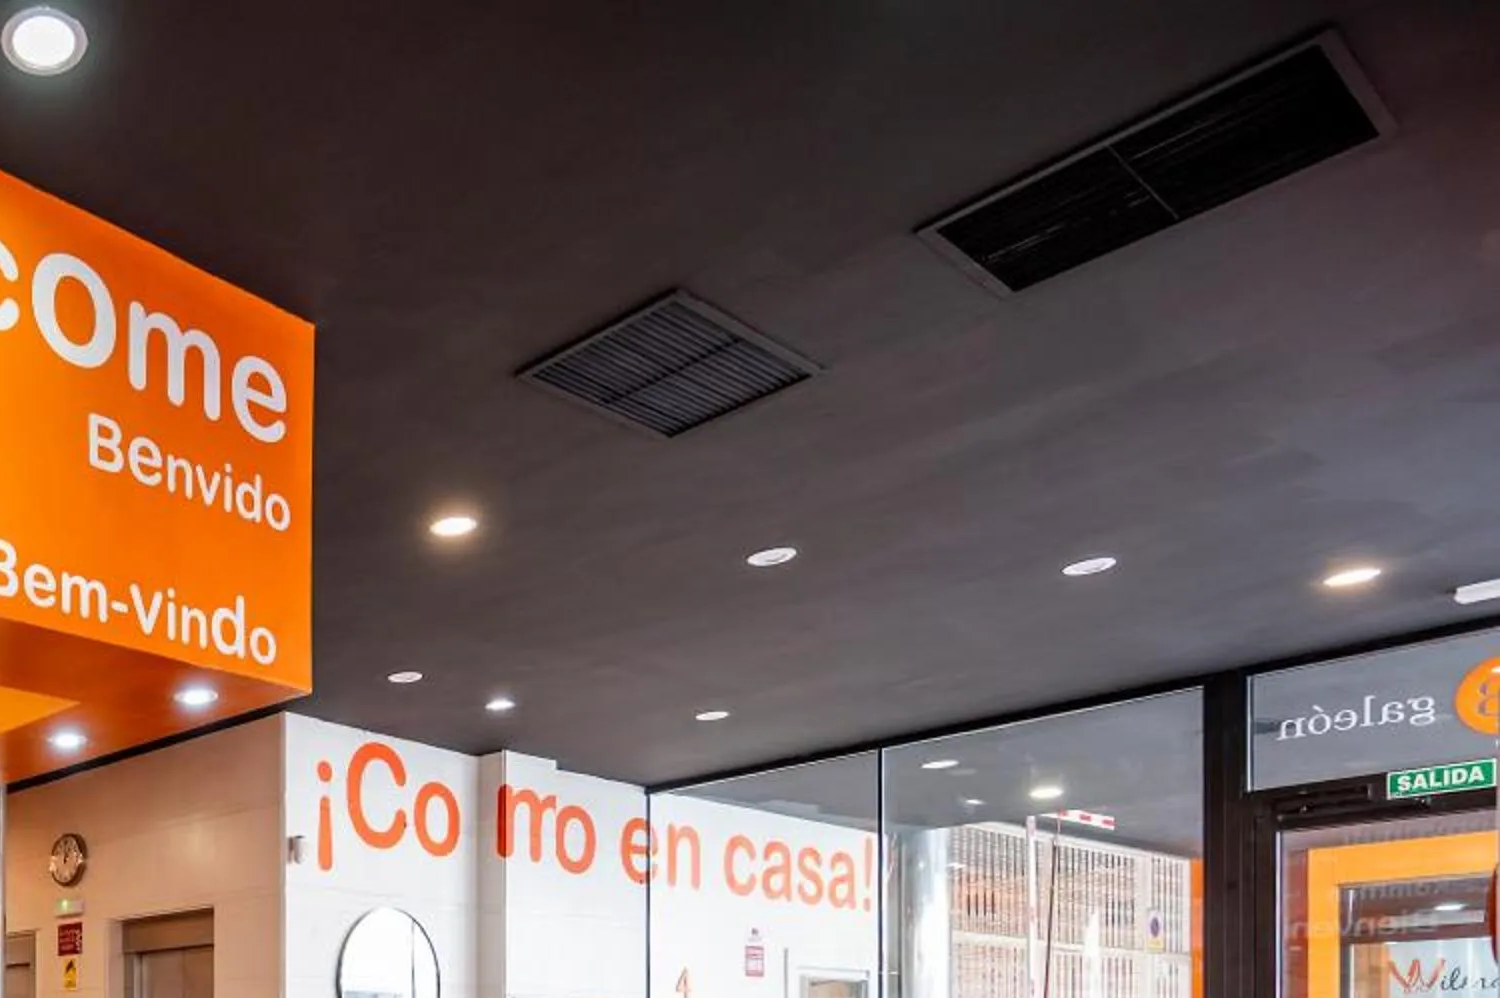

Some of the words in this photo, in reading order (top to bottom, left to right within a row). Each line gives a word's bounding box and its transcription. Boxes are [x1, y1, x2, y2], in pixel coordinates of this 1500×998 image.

[89, 414, 291, 532] Benvido
[1397, 765, 1485, 793] SALIDA
[620, 816, 701, 890] en
[723, 834, 874, 912] casa!
